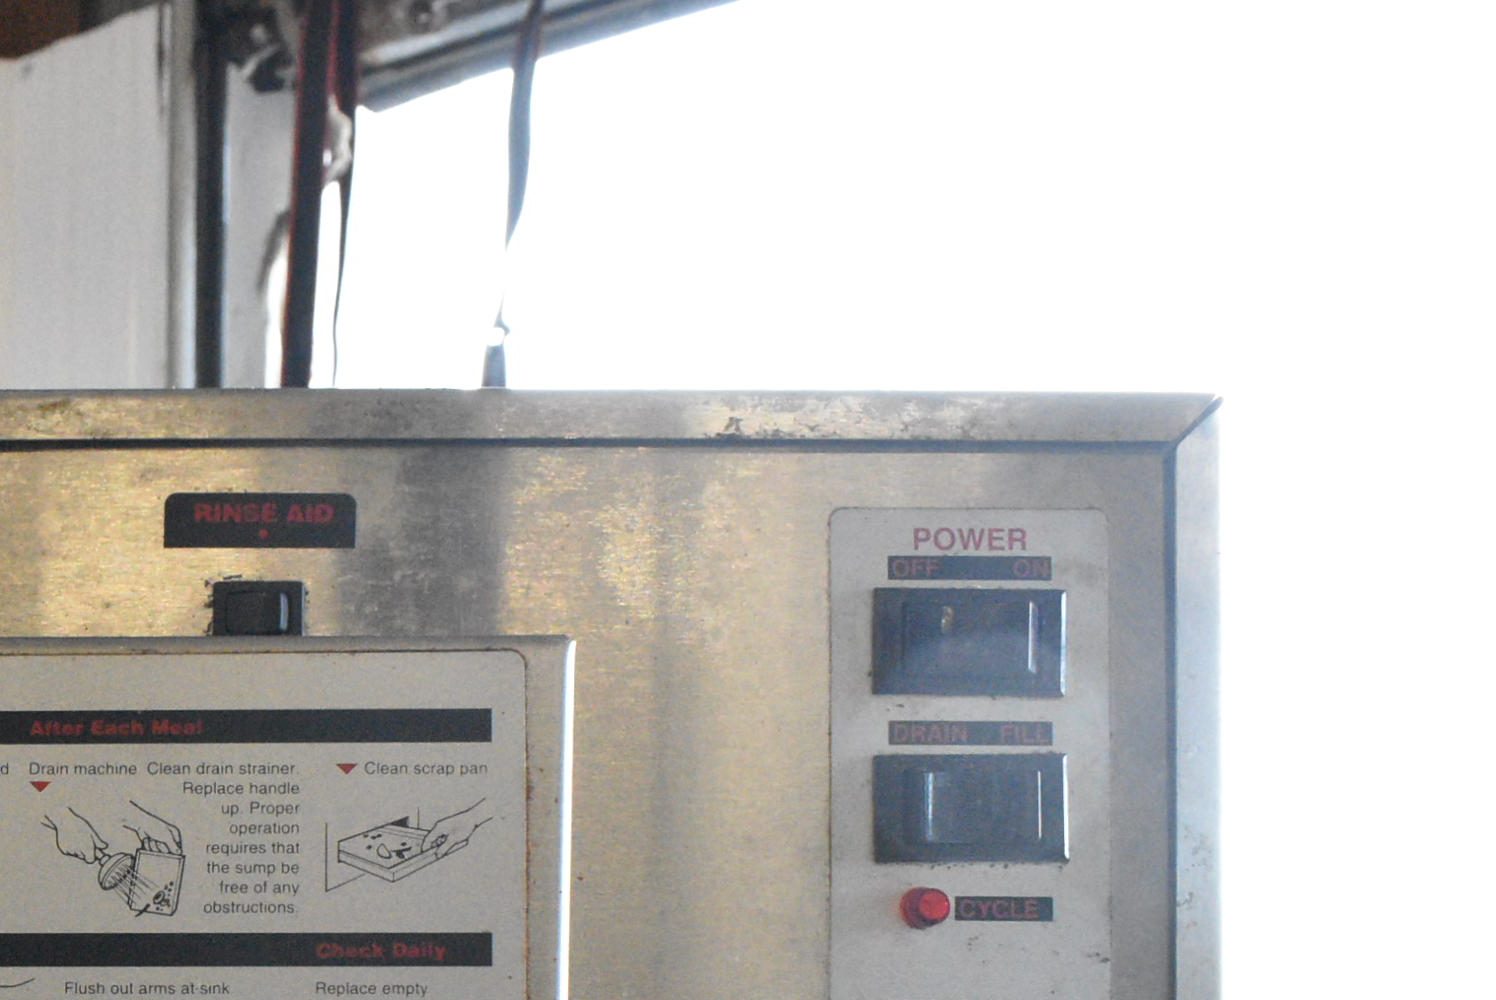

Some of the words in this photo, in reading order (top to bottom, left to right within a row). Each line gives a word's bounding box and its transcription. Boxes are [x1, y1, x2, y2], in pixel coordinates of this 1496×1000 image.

[195, 503, 276, 523] RINSE
[288, 504, 334, 523] AID
[911, 528, 1028, 552] POWER
[892, 559, 941, 576] OFF
[1013, 559, 1051, 576] ON
[31, 720, 84, 735] After
[91, 720, 144, 736] Each
[152, 720, 203, 734] Meal
[892, 724, 969, 743] DRAIN
[999, 724, 1049, 743] FILL
[29, 762, 68, 775] Drain
[147, 761, 191, 775] Clean
[196, 762, 233, 775] drain
[364, 761, 408, 775] Clean
[414, 764, 455, 776] scrap
[183, 781, 244, 797] Replace
[249, 782, 299, 795] handle
[250, 801, 300, 817] Proper
[229, 823, 299, 836] operation
[206, 844, 266, 856] requires
[271, 842, 299, 854] that
[207, 862, 229, 874] the
[235, 864, 276, 877] sump
[281, 862, 299, 874] be
[219, 880, 248, 894] free
[253, 881, 267, 894] of
[273, 883, 299, 896] any
[959, 898, 1039, 918] CYCLE
[316, 943, 384, 958] Check
[393, 942, 447, 960] Daily
[65, 982, 105, 994] Flush
[110, 983, 133, 995] out
[139, 985, 176, 995] arms
[315, 982, 376, 997] Replace
[382, 983, 427, 997] empty
